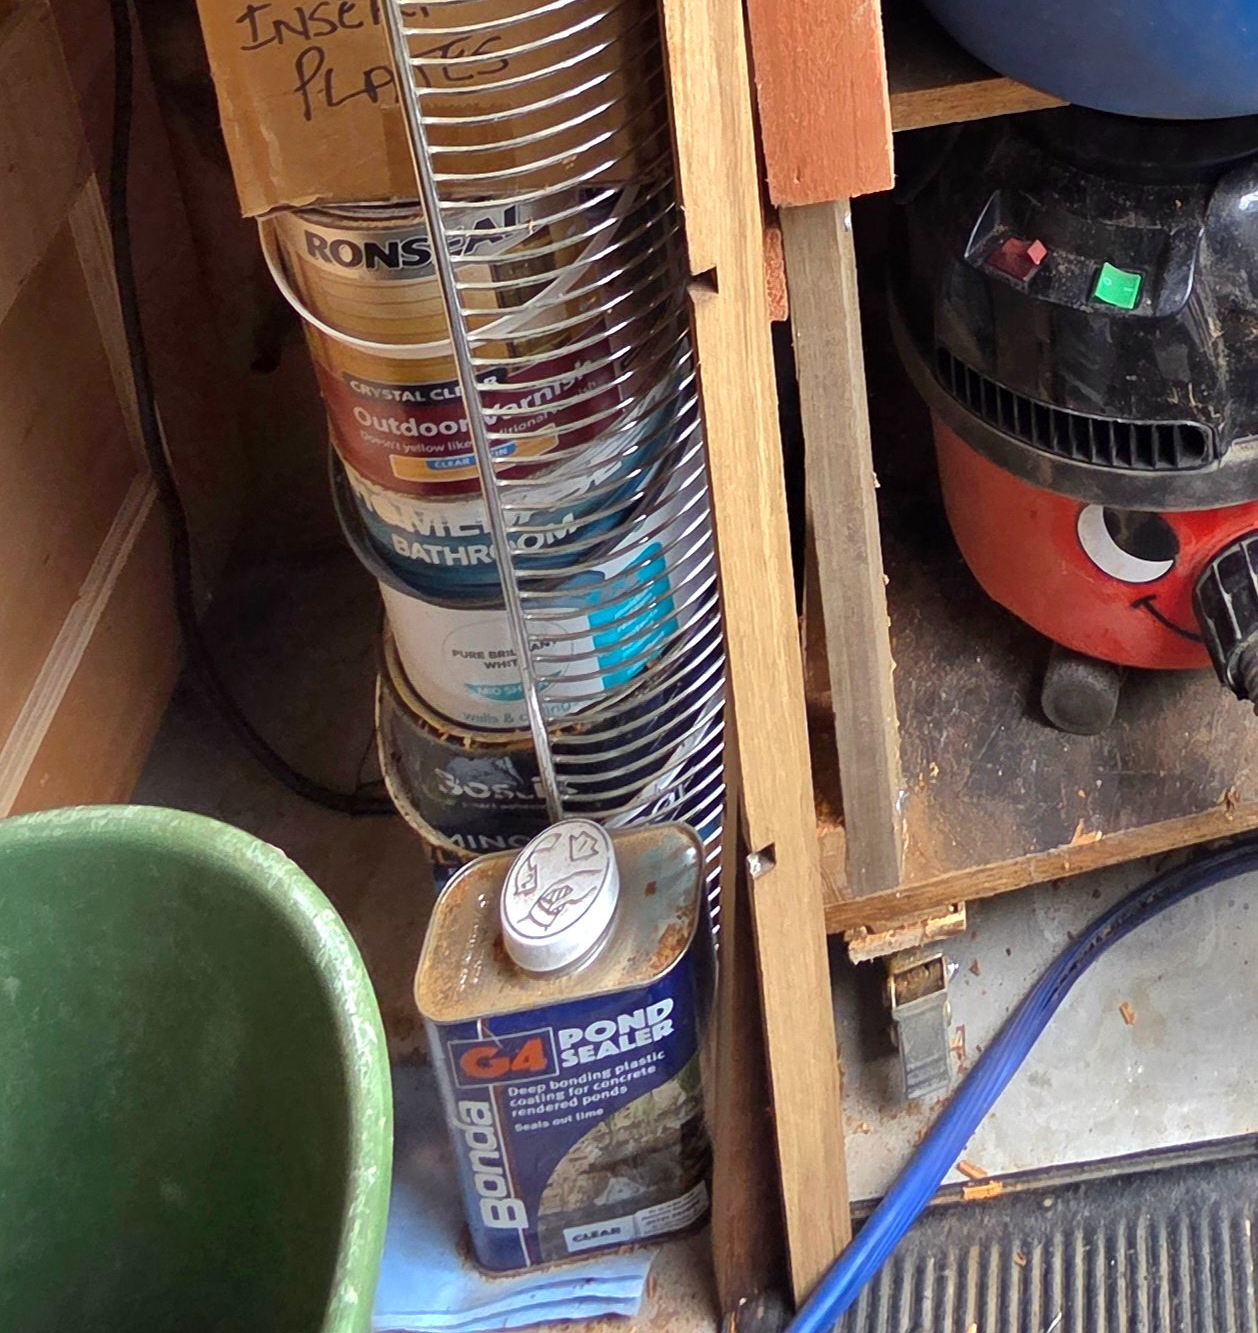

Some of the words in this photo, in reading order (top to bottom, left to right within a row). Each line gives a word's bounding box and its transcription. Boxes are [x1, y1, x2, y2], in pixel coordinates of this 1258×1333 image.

[294, 35, 509, 121] PLATES
[350, 379, 426, 402] CRYSTAL
[430, 375, 498, 400] CLER
[353, 406, 470, 437] Outdoor
[403, 441, 445, 454] yellow
[448, 439, 472, 451] like
[434, 457, 470, 468] CLEAR
[452, 649, 485, 660] PURE
[484, 658, 518, 670] WHIT
[558, 997, 675, 1051] POND
[459, 1036, 548, 1079] G4
[560, 1018, 675, 1068] SEALER
[508, 1083, 547, 1098] Deep
[551, 1071, 612, 1091] bonding
[615, 1050, 666, 1075] plastic
[509, 1089, 566, 1109] coating
[568, 1085, 590, 1097] for
[593, 1065, 657, 1091] concrete
[512, 1097, 579, 1118] rendered
[582, 1084, 628, 1106] ponds
[514, 1119, 550, 1133] Seals
[552, 1113, 574, 1126] out
[576, 1106, 604, 1121] lime
[449, 1100, 529, 1230] Bonda
[572, 1226, 622, 1242] CLEAR
